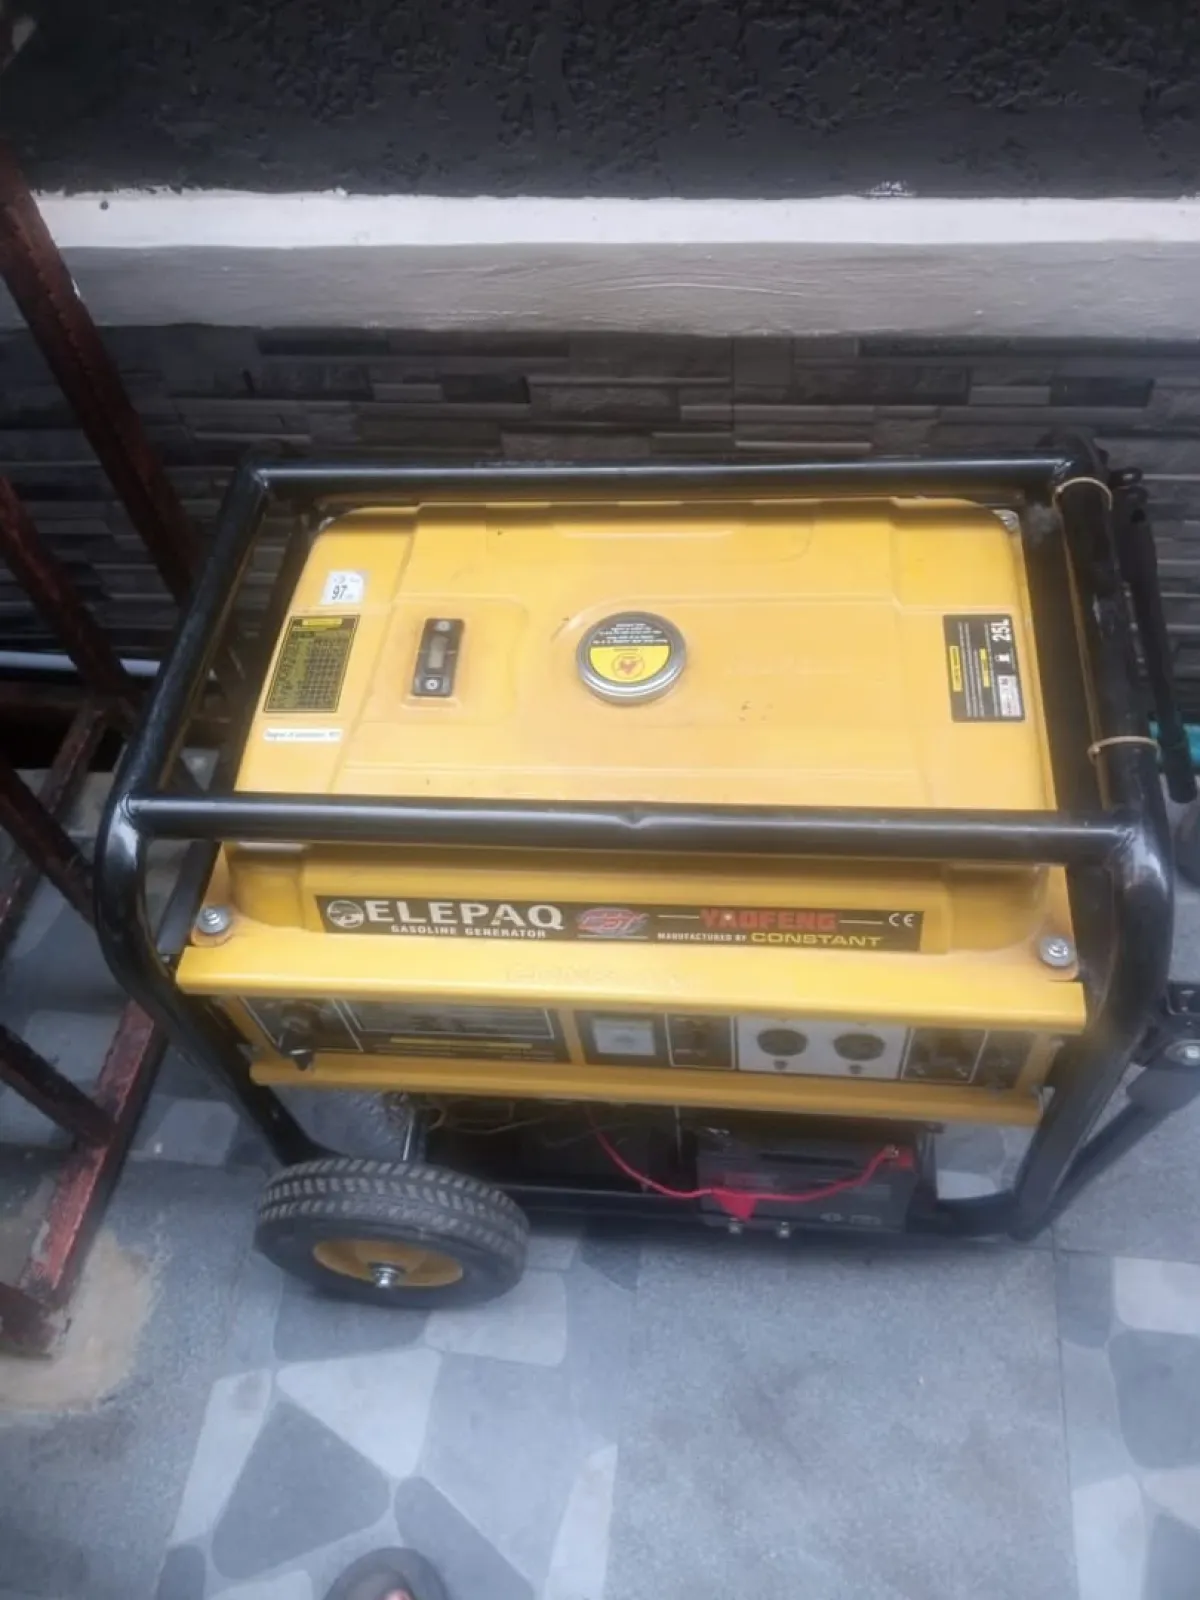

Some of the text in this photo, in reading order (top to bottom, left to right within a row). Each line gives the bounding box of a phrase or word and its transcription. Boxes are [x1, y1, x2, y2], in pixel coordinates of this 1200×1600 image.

[331, 584, 347, 600] 97
[990, 618, 1011, 642] 25L
[364, 900, 565, 931] ELEPAQ
[700, 907, 839, 931] YAOFENG
[391, 923, 547, 939] GASOLINE GENERATOR
[657, 932, 884, 947] MANUFACTURED BY CONSTANT
